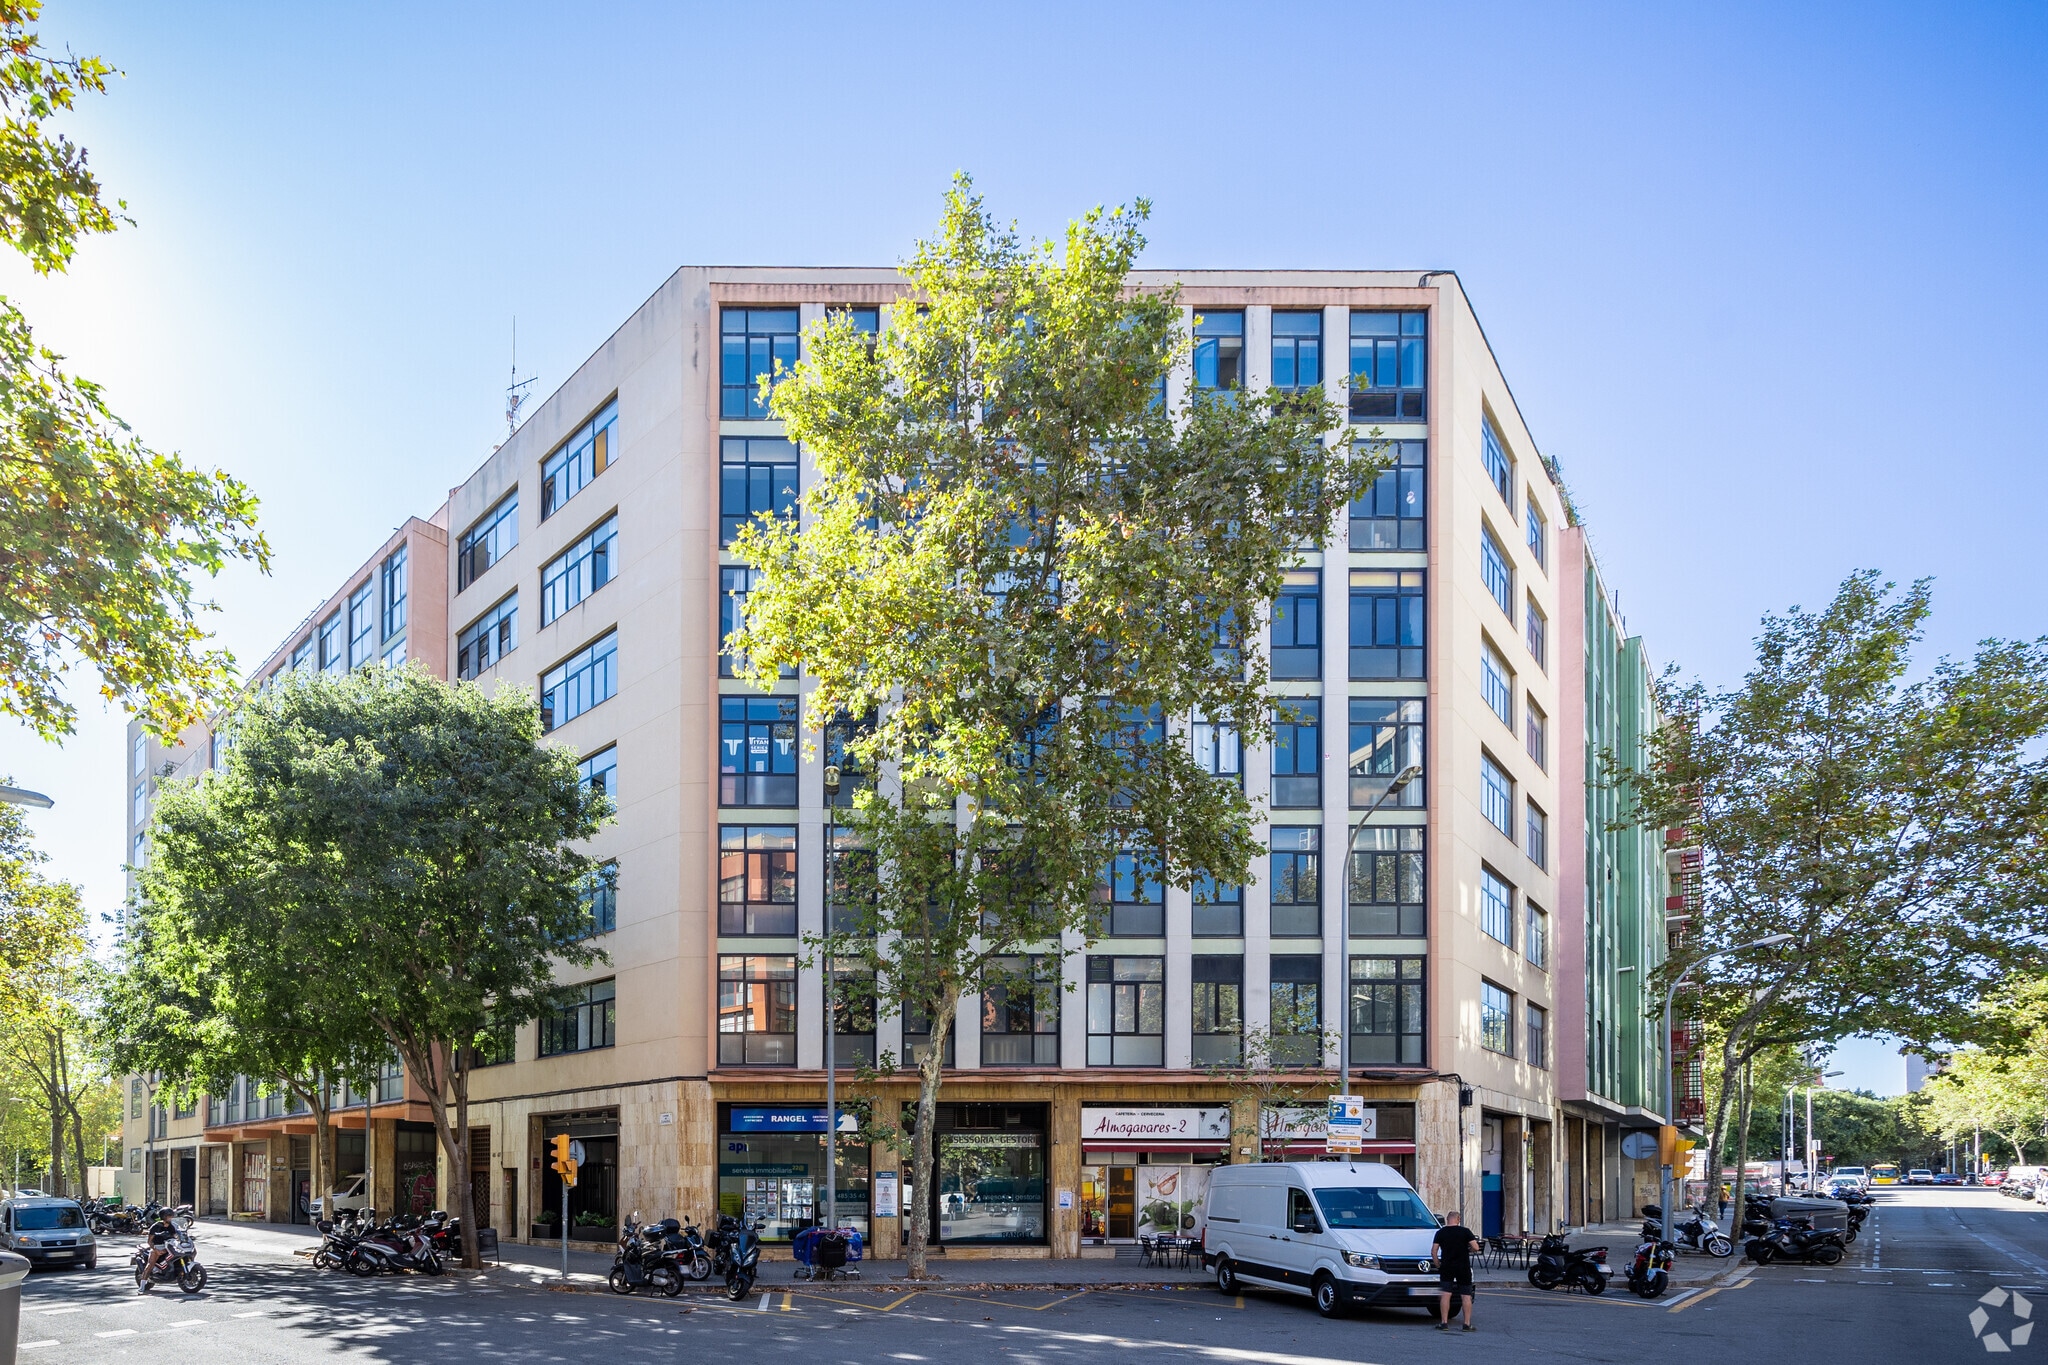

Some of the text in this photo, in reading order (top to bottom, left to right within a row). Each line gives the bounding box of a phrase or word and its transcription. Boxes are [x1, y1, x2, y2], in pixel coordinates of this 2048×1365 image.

[771, 1115, 807, 1123] RANGEL
[756, 1166, 792, 1174] immobiliaris
[1015, 1194, 1041, 1202] gestoria
